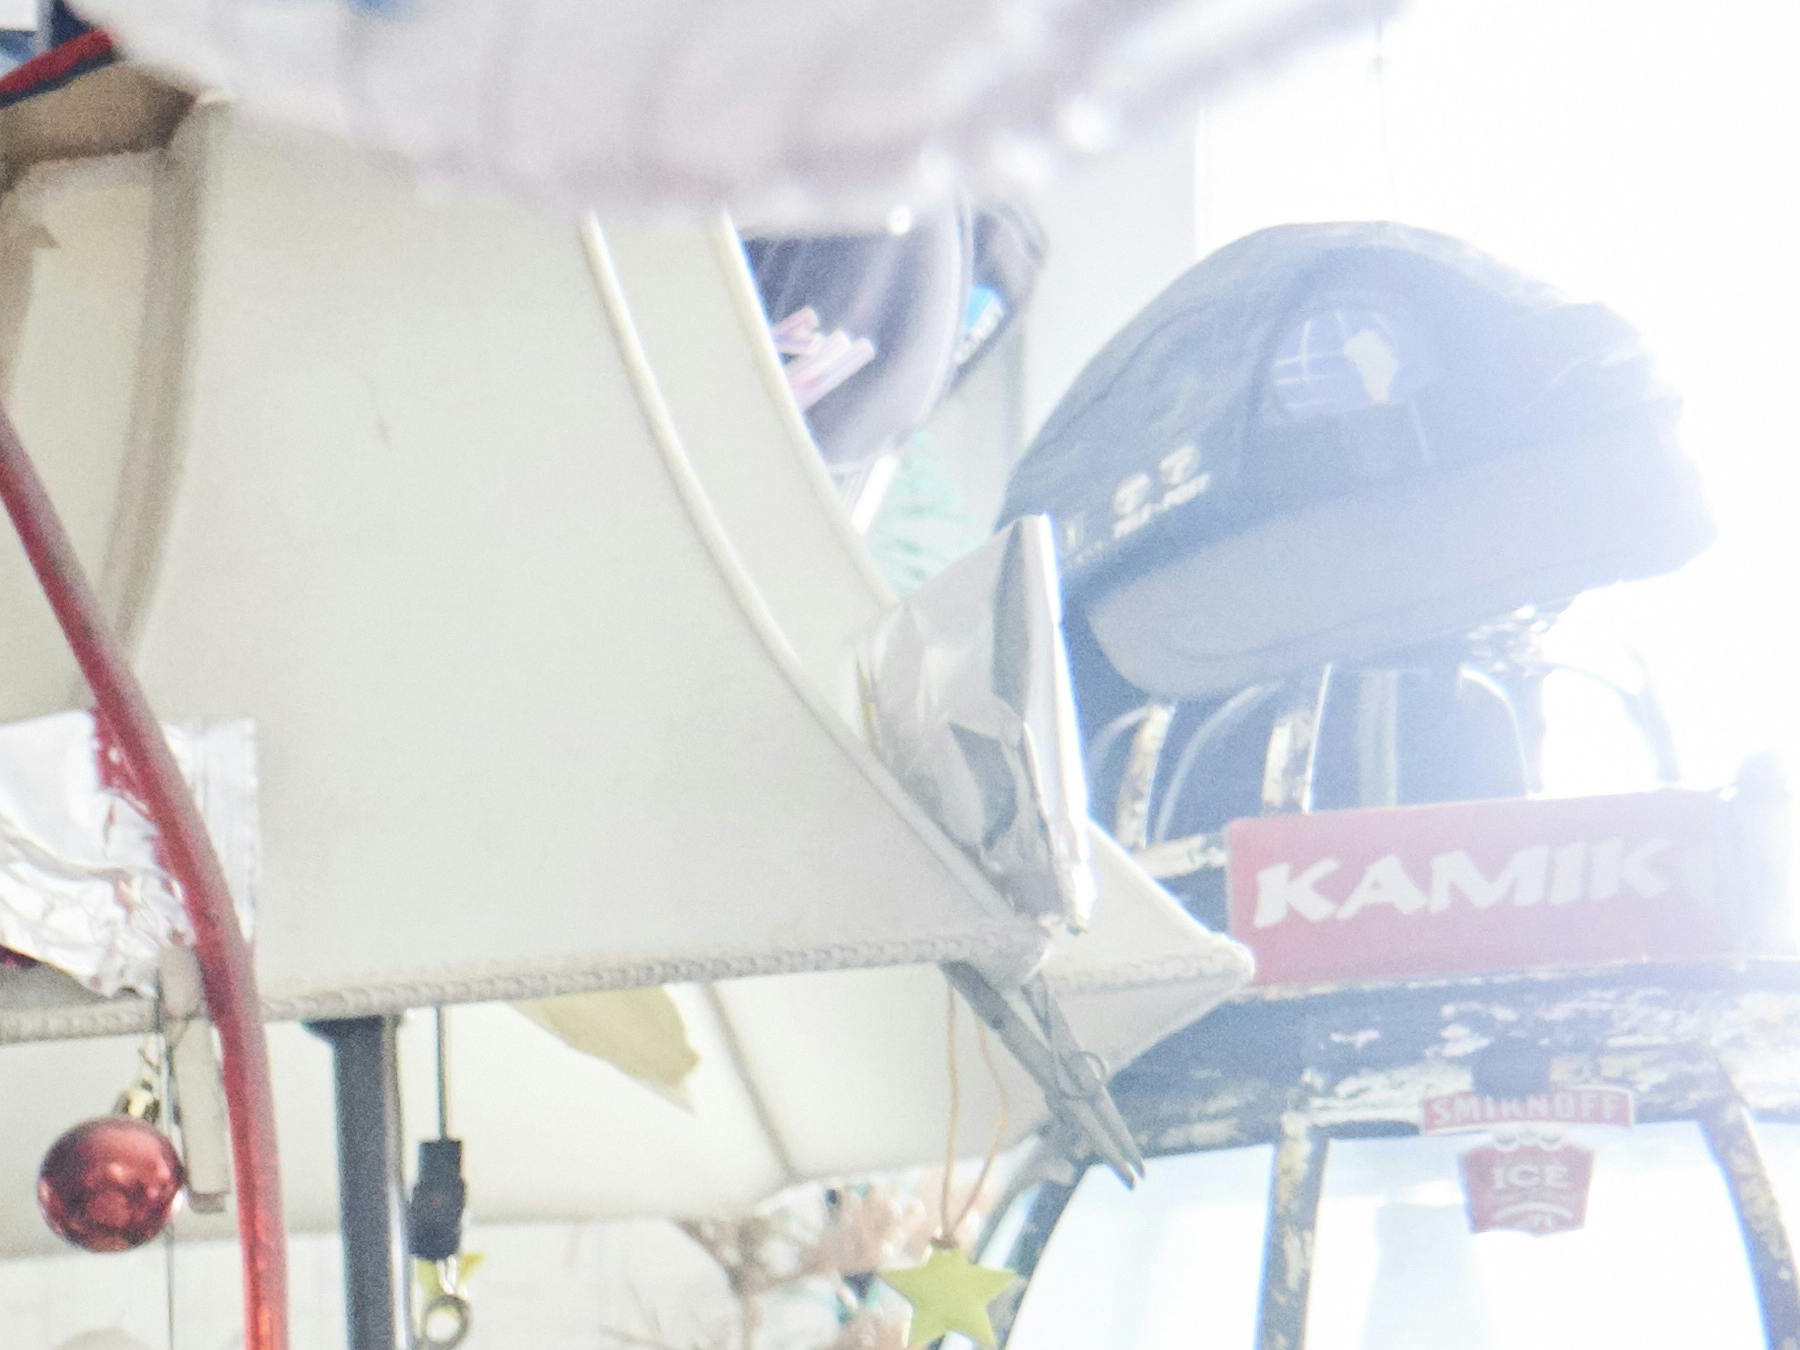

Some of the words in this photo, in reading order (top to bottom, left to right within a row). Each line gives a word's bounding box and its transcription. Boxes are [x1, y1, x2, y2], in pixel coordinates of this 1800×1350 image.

[1252, 836, 1668, 929] KAMIK
[1431, 1092, 1620, 1126] SMIRNOFF
[1494, 1164, 1568, 1190] ICE
